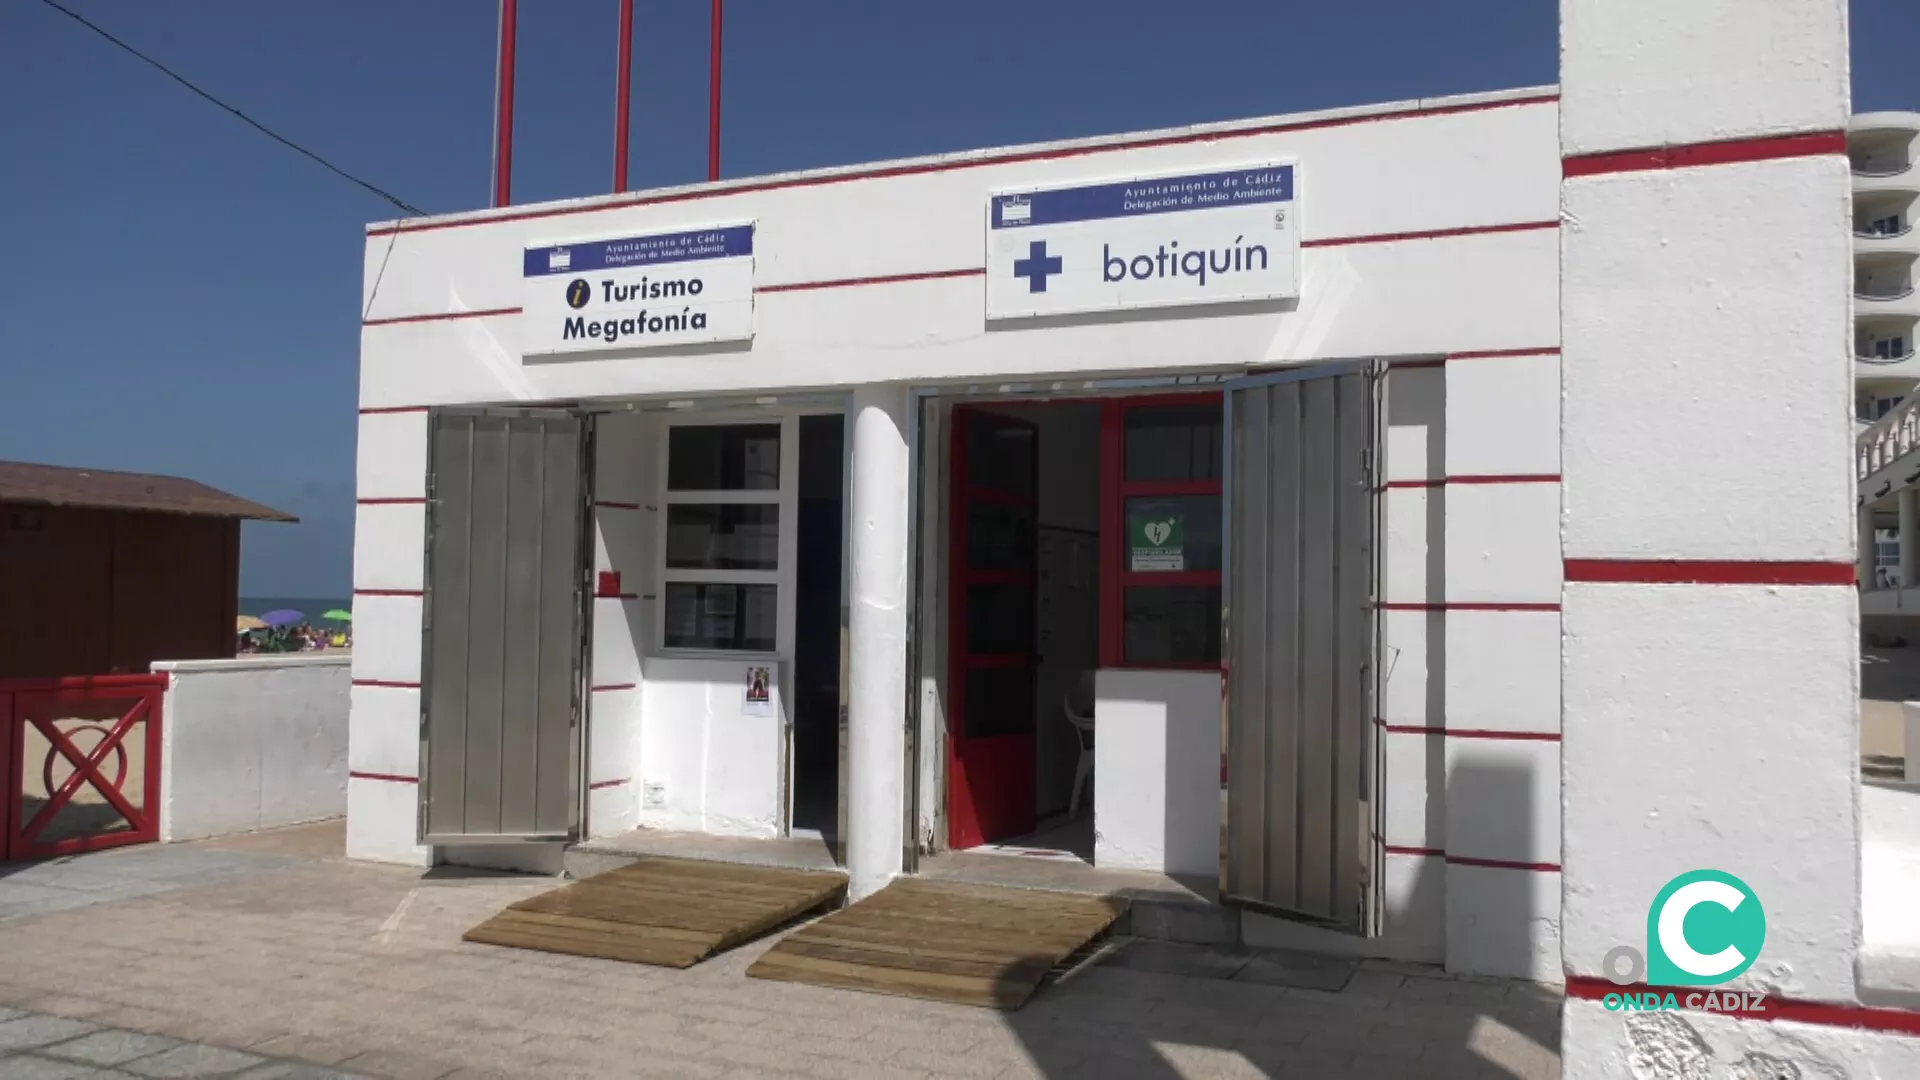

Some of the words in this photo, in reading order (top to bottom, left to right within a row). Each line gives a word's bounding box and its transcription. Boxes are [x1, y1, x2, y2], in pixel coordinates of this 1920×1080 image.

[1124, 179, 1217, 198] Ayuntamiento
[1222, 177, 1239, 188] de
[1245, 172, 1282, 186] Cádiz
[1124, 194, 1178, 210] Delegación
[1180, 193, 1194, 205] de
[1197, 190, 1230, 204] Medio
[1232, 186, 1282, 201] Ambiente
[605, 251, 647, 264] Delegación
[648, 249, 658, 259] de
[660, 247, 686, 259] Medio
[687, 243, 725, 255] Ambiente
[606, 239, 676, 254] Ayuntamiento
[680, 236, 692, 246] de
[696, 233, 725, 244] Cádiz
[1103, 235, 1268, 286] botiquín
[601, 275, 704, 303] Turismo
[563, 306, 707, 342] Megafonía
